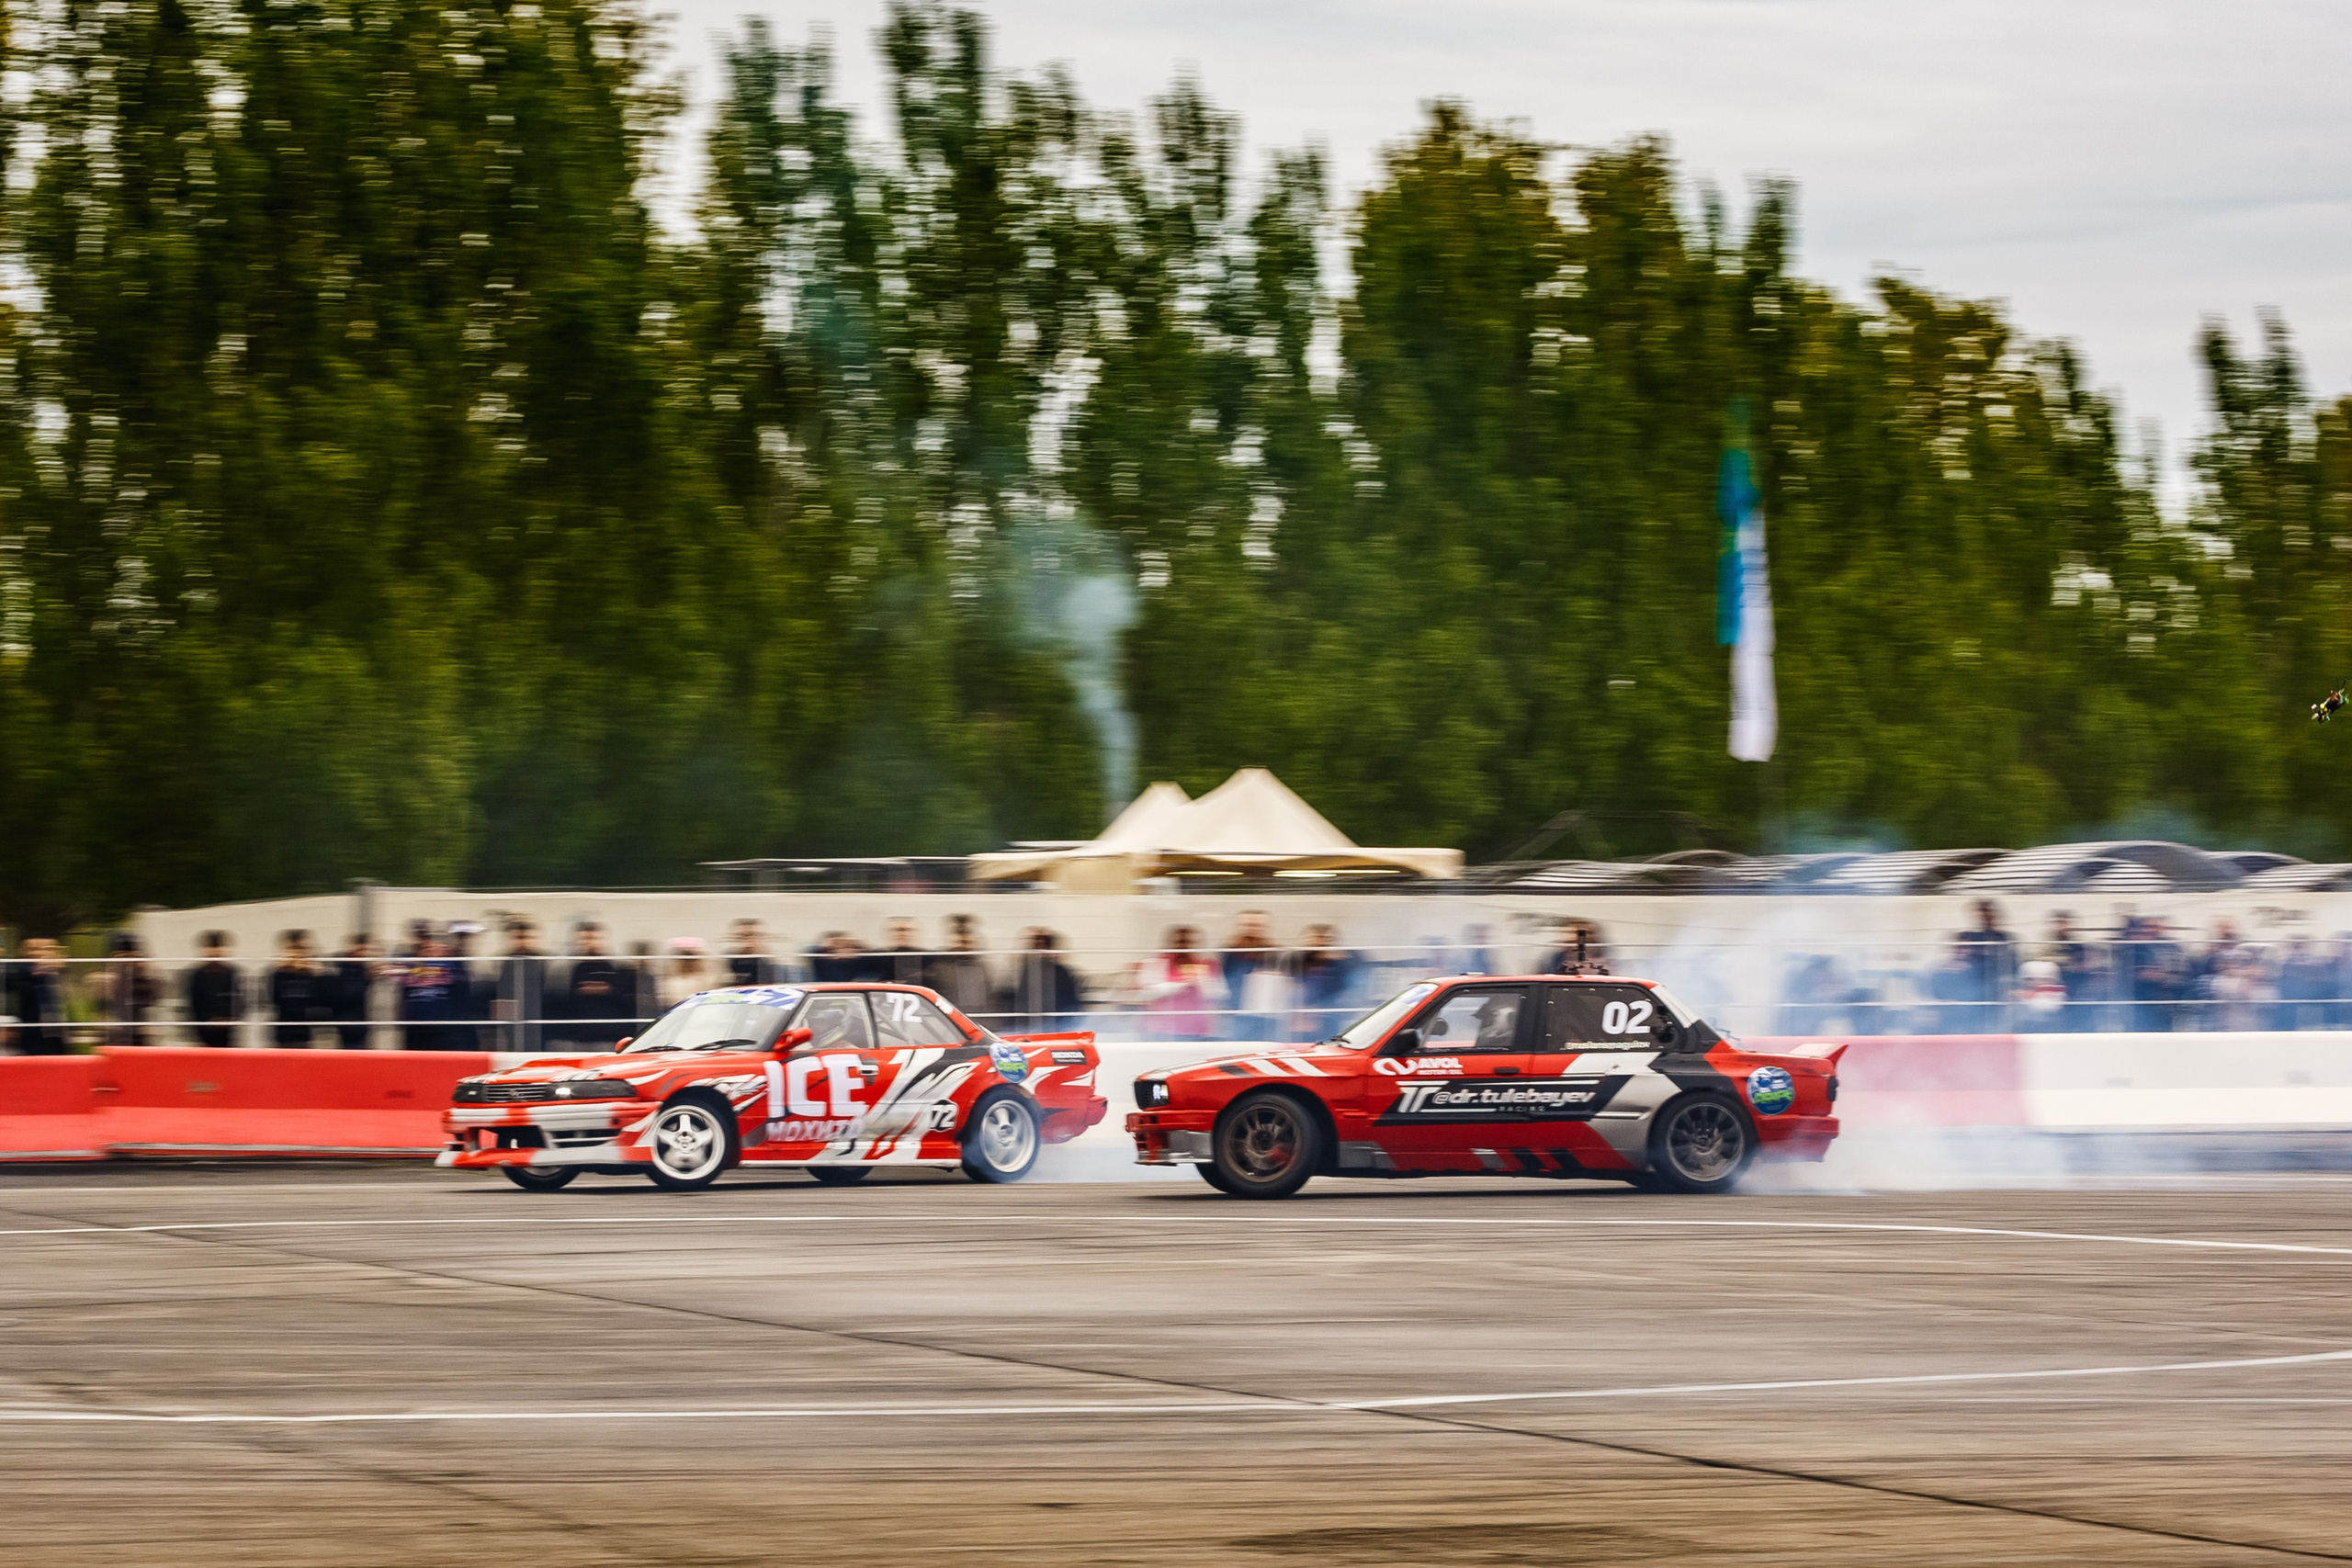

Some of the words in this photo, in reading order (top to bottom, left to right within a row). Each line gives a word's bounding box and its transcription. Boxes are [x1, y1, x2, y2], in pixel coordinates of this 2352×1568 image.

[886, 992, 922, 1023] 72
[1601, 1000, 1653, 1035] 02
[763, 1054, 869, 1118] ICE
[1431, 1088, 1597, 1107] @dr.tulebayev
[929, 1104, 958, 1128] 72
